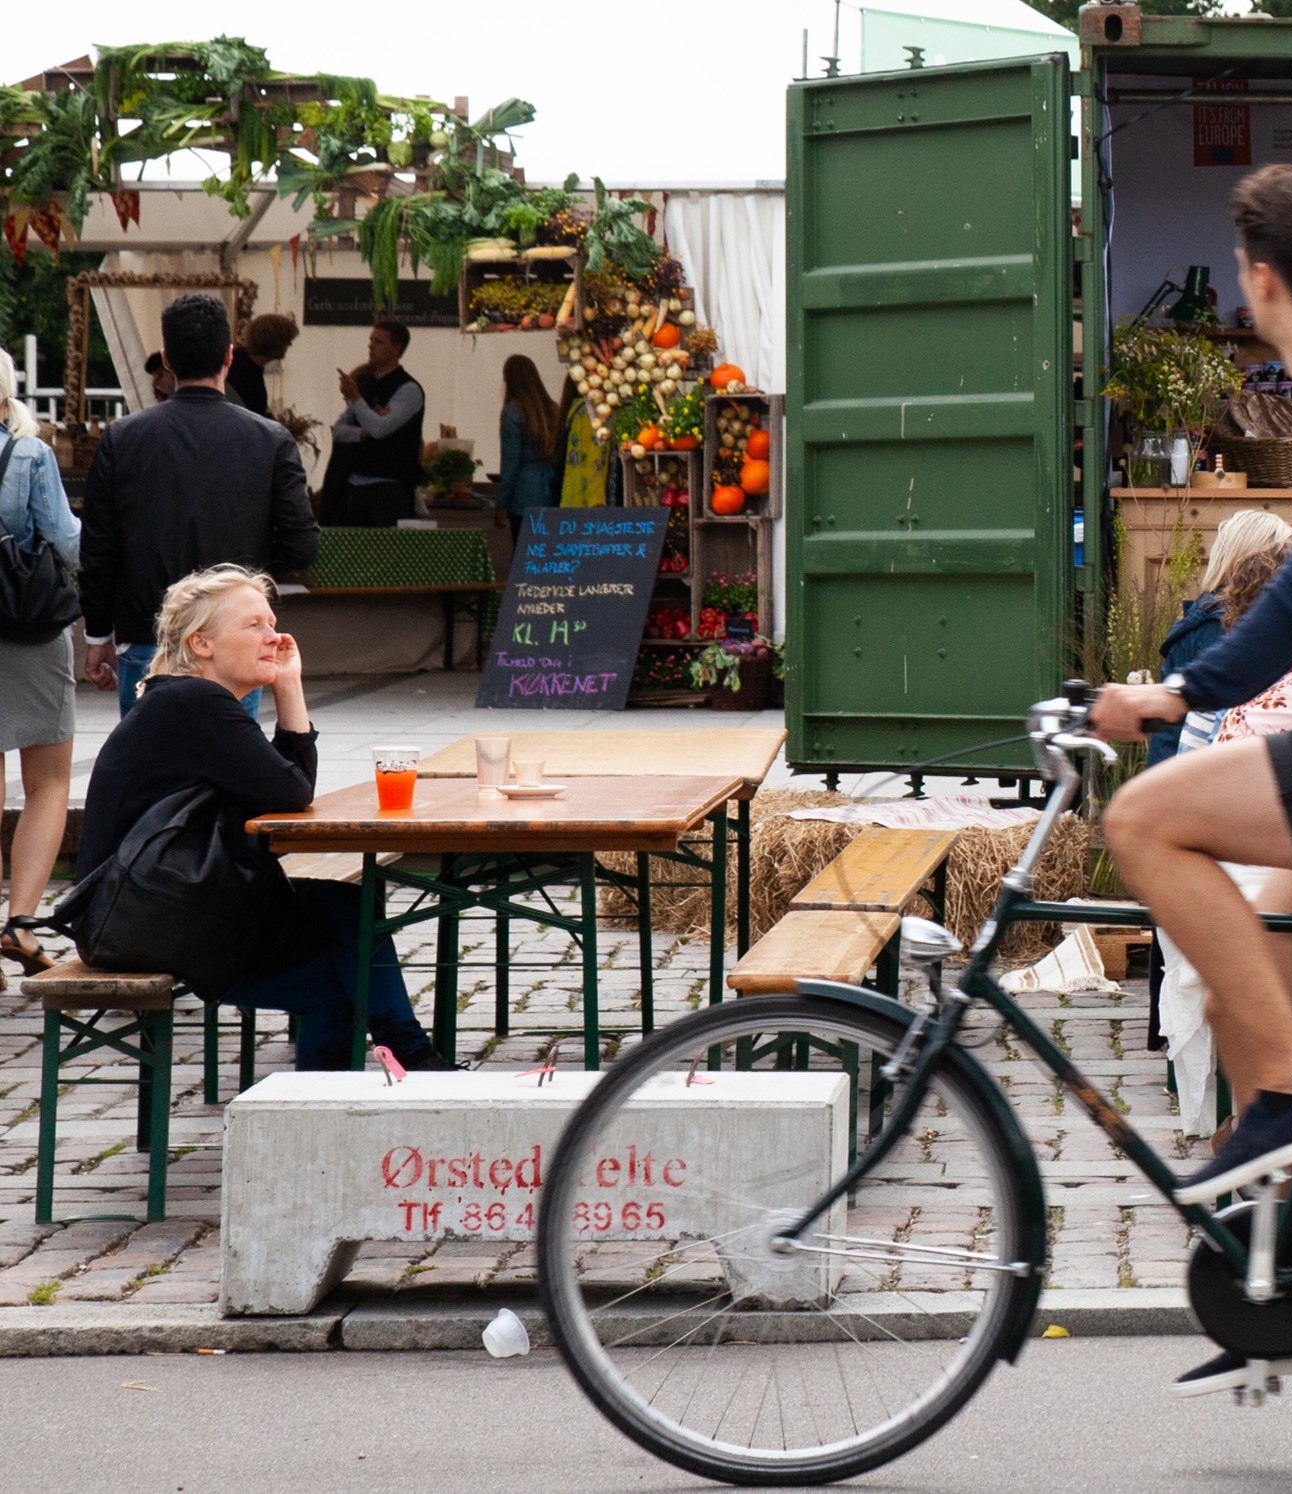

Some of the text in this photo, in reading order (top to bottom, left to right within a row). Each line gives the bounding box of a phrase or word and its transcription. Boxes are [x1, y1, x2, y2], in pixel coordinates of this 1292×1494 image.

[1199, 107, 1245, 124] IT'S FROM
[1199, 124, 1245, 146] EUROPE
[559, 520, 577, 536] DU
[512, 622, 539, 646] KL.
[509, 671, 619, 698] KØKKENET
[380, 1144, 543, 1190] Ørsted
[462, 1201, 506, 1232] 86
[515, 1201, 536, 1232] 4
[620, 1201, 667, 1232] 65
